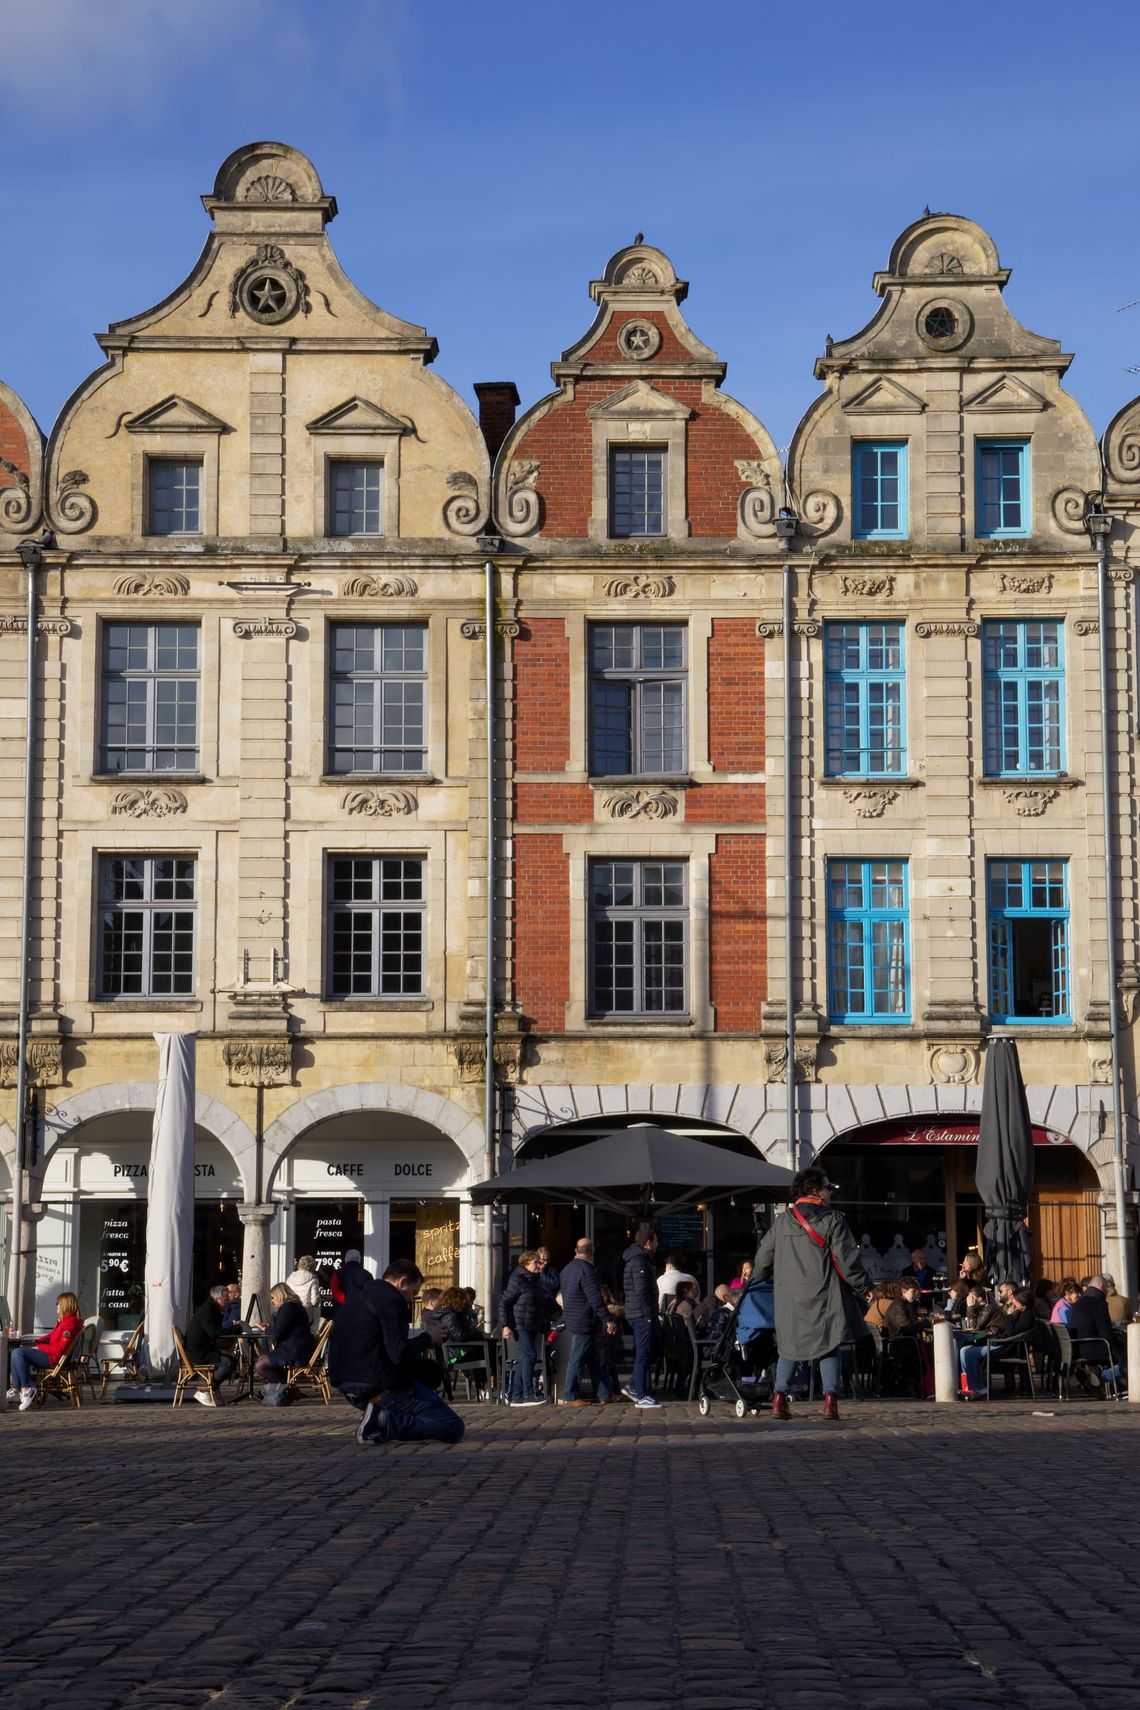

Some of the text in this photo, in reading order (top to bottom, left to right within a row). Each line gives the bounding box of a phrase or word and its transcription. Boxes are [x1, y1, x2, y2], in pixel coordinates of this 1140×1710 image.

[904, 1123, 981, 1142] L'Estamin
[114, 1164, 215, 1177] PIZZA STA
[327, 1163, 432, 1176] CAFFE DOLCE
[104, 1218, 128, 1229] pizza
[316, 1218, 342, 1228] pasta
[100, 1230, 129, 1240] fresca
[314, 1228, 343, 1239] fresca
[101, 1287, 125, 1298] fatta
